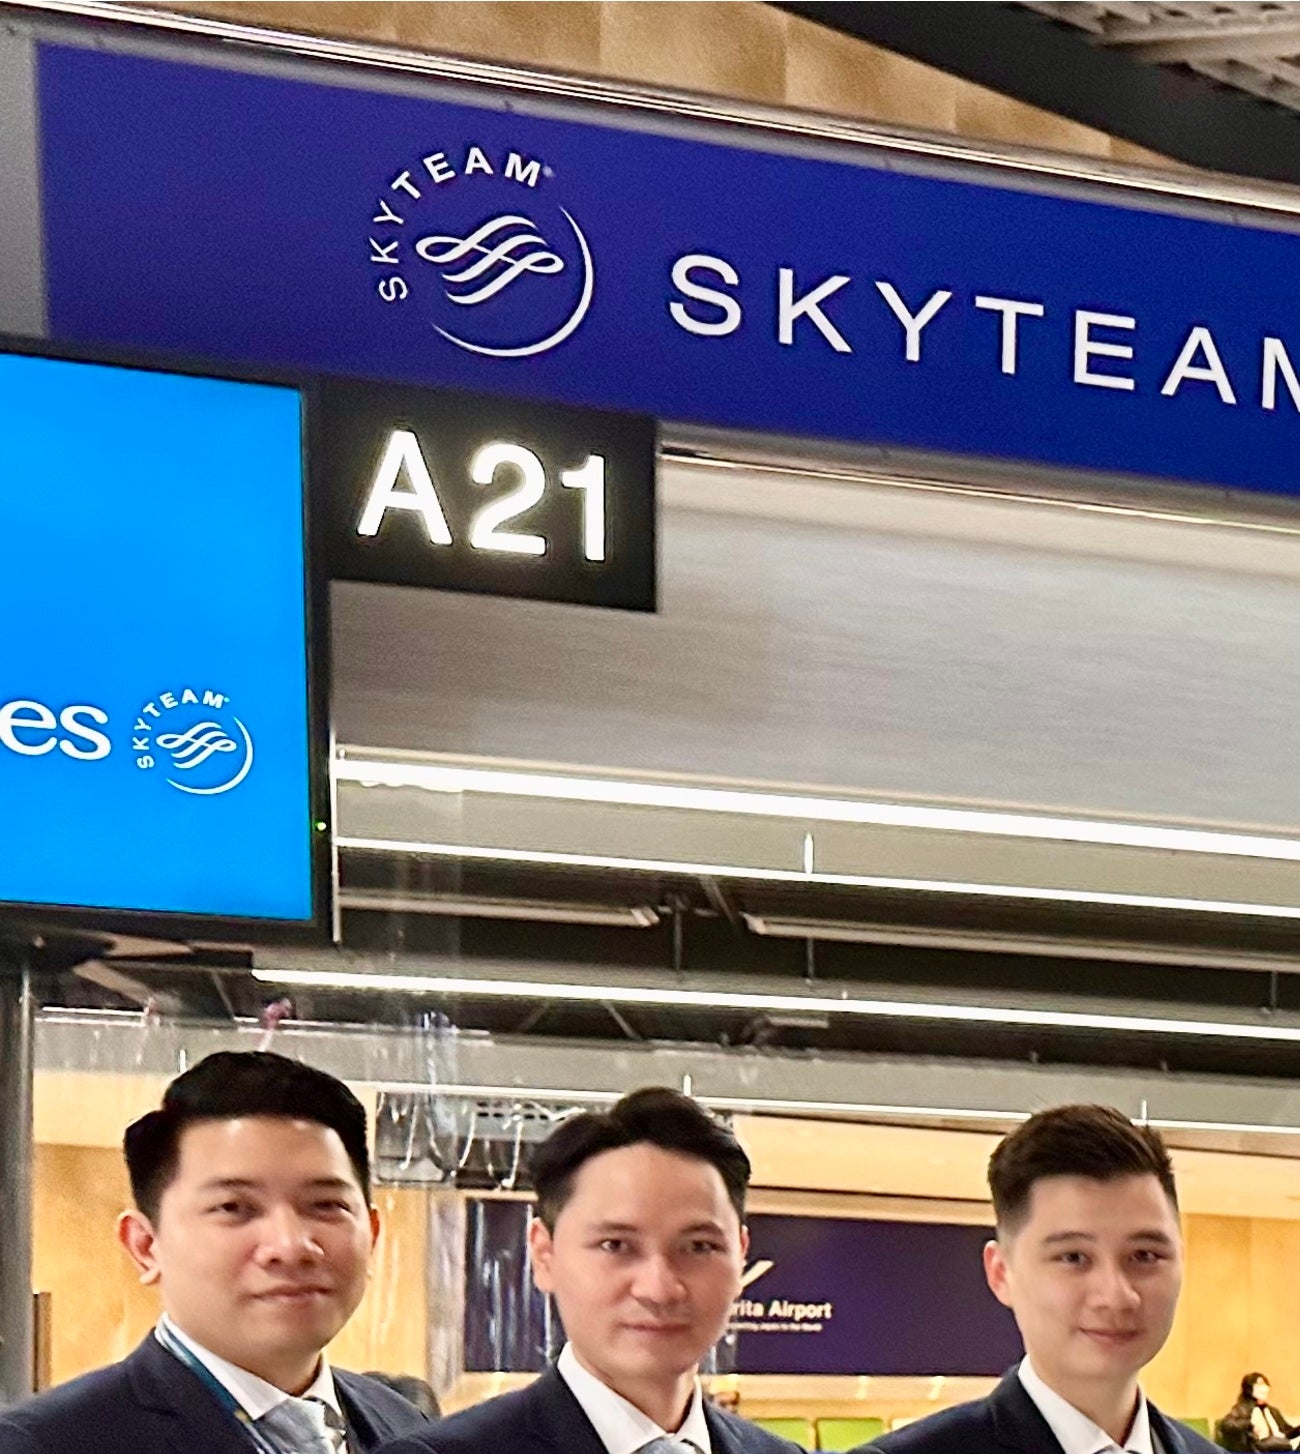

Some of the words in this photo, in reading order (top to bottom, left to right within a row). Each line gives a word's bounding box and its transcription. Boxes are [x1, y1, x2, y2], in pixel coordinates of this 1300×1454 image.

[369, 146, 541, 303] SKYTEAM
[357, 429, 607, 562] A21
[132, 688, 225, 770] SKYTEAM
[768, 1300, 832, 1322] Airport
